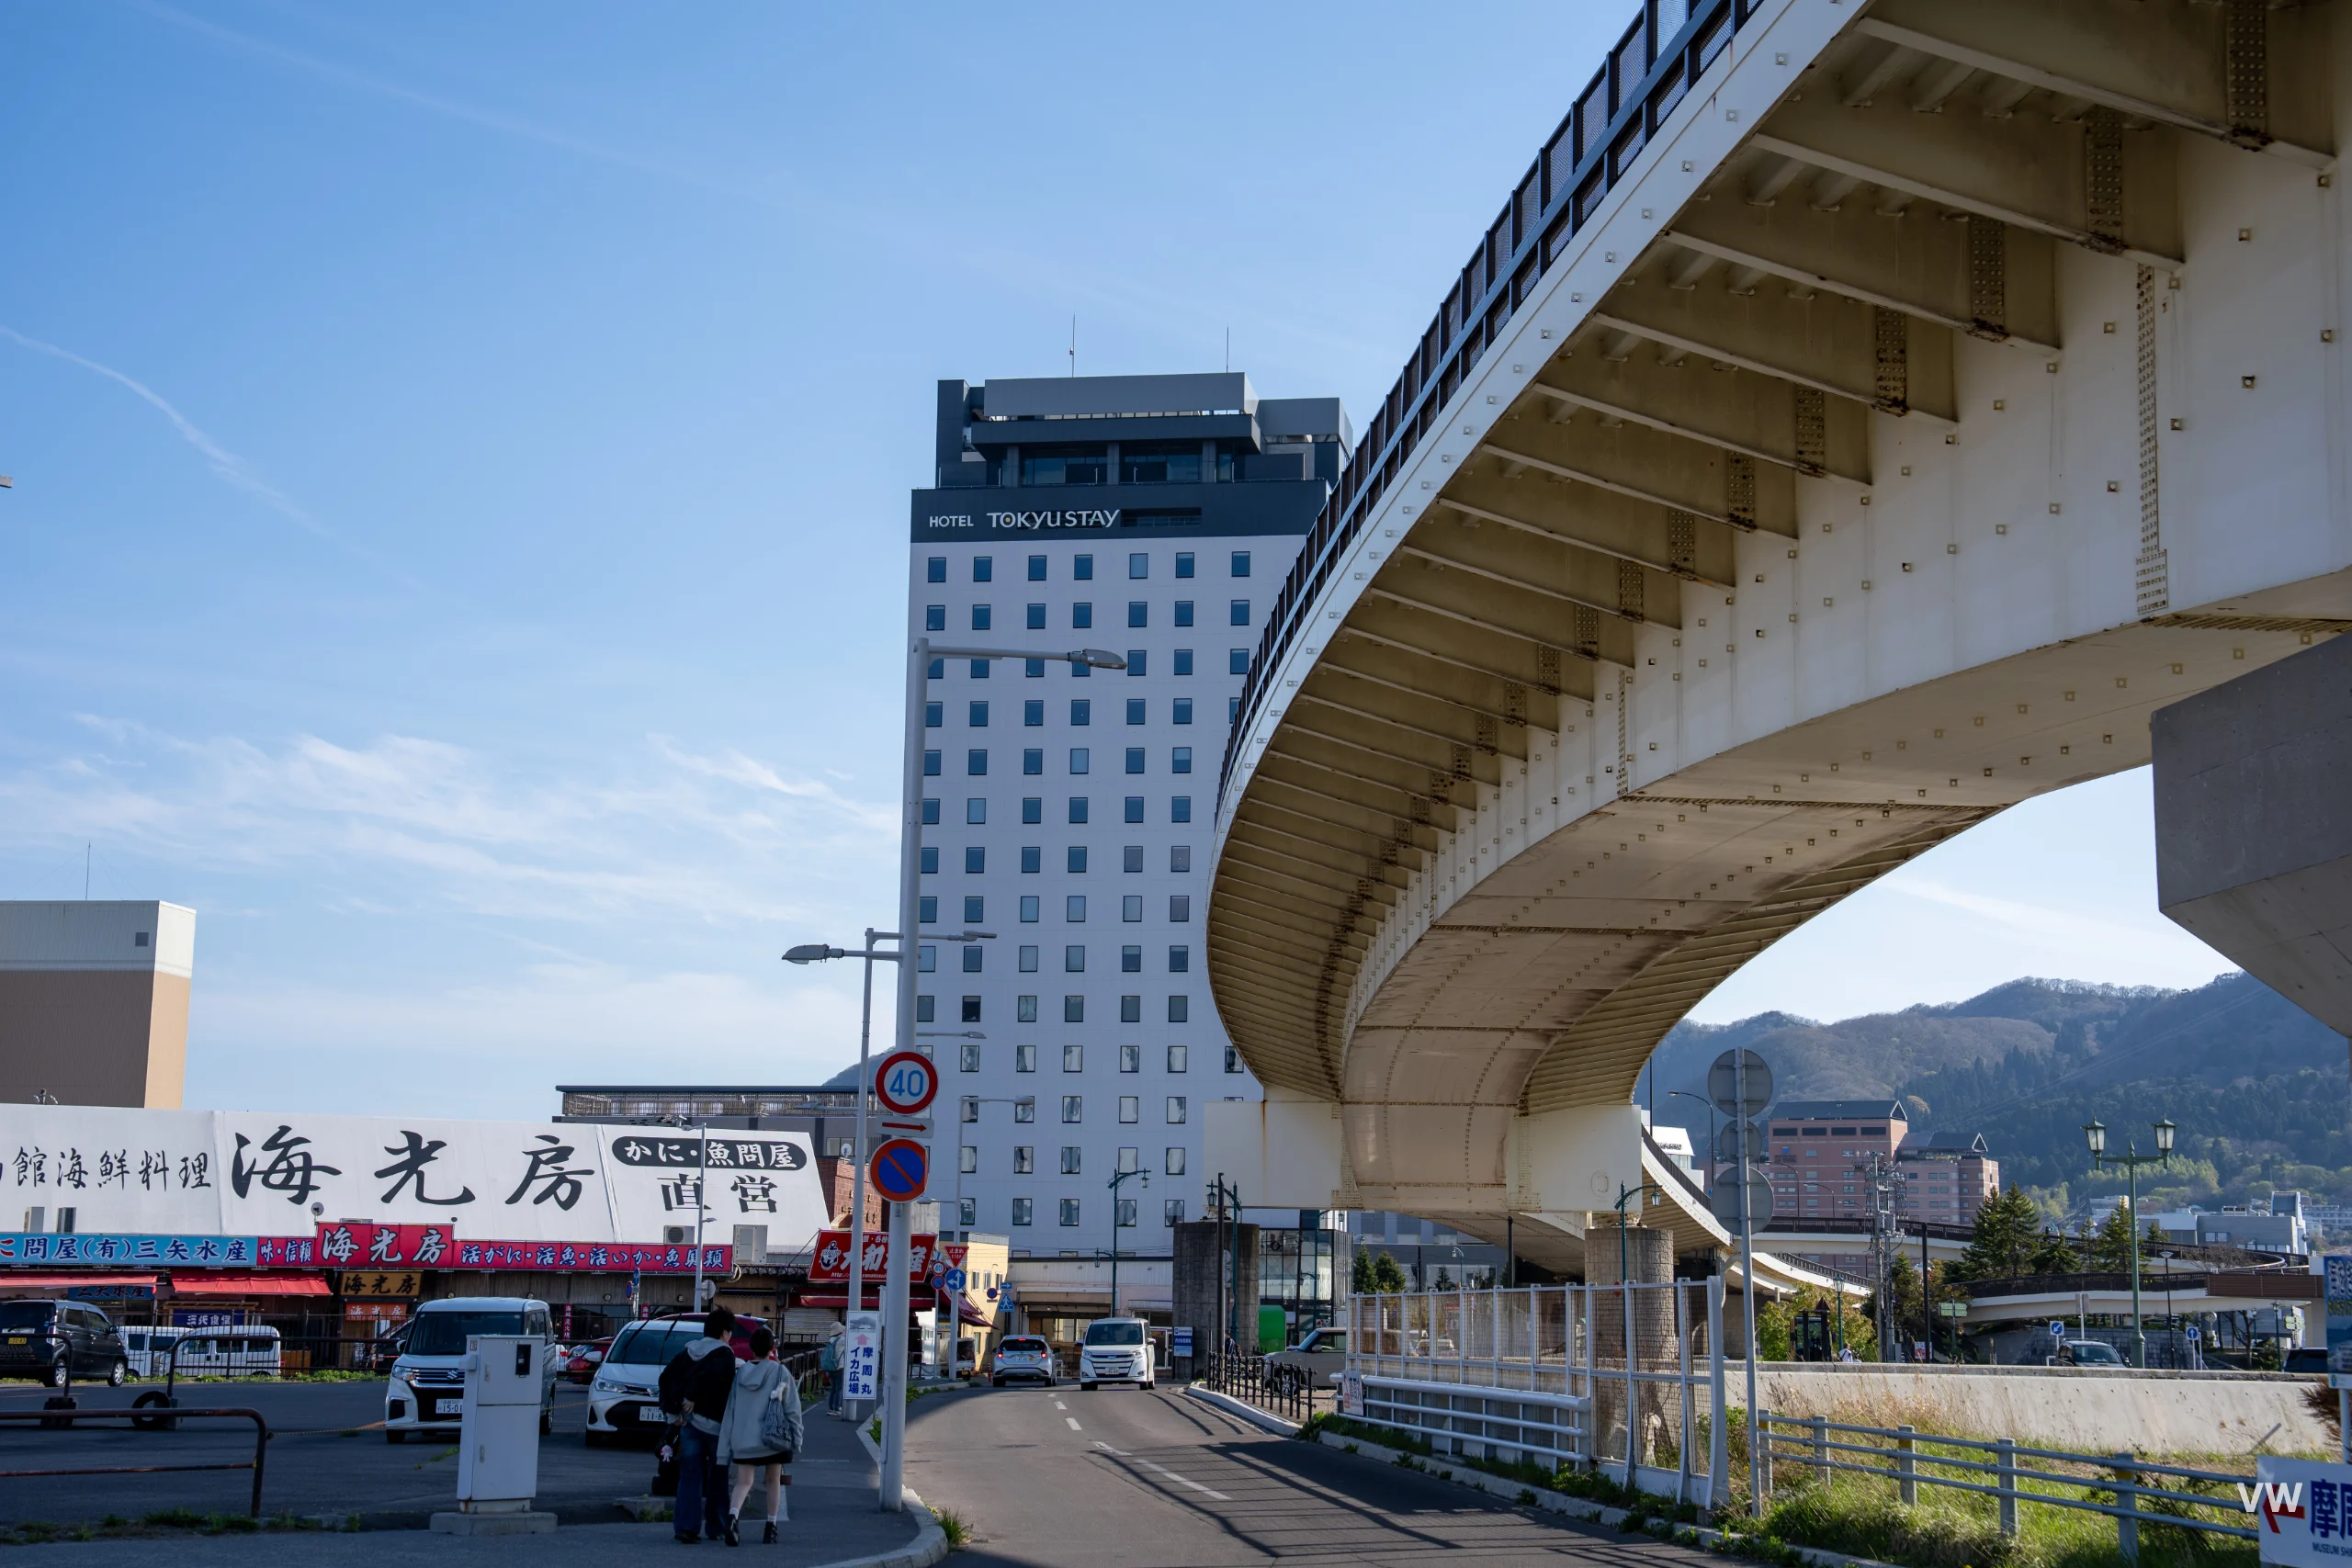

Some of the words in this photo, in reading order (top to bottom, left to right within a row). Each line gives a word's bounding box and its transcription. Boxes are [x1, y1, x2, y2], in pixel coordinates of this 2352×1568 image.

[929, 515, 974, 527] HOTEL
[889, 1068, 924, 1098] 40
[0, 1146, 211, 1192] 館海鮮料理
[232, 1124, 595, 1211] 海光房
[624, 1141, 797, 1168] かに・魚問屋
[657, 1173, 778, 1213] 直営
[322, 1226, 447, 1265] 海光房
[344, 1274, 417, 1295] 海光房
[848, 1347, 861, 1394] イカ広場
[862, 1347, 874, 1394] 摩周丸
[2312, 1543, 2339, 1554] MUSEUM
